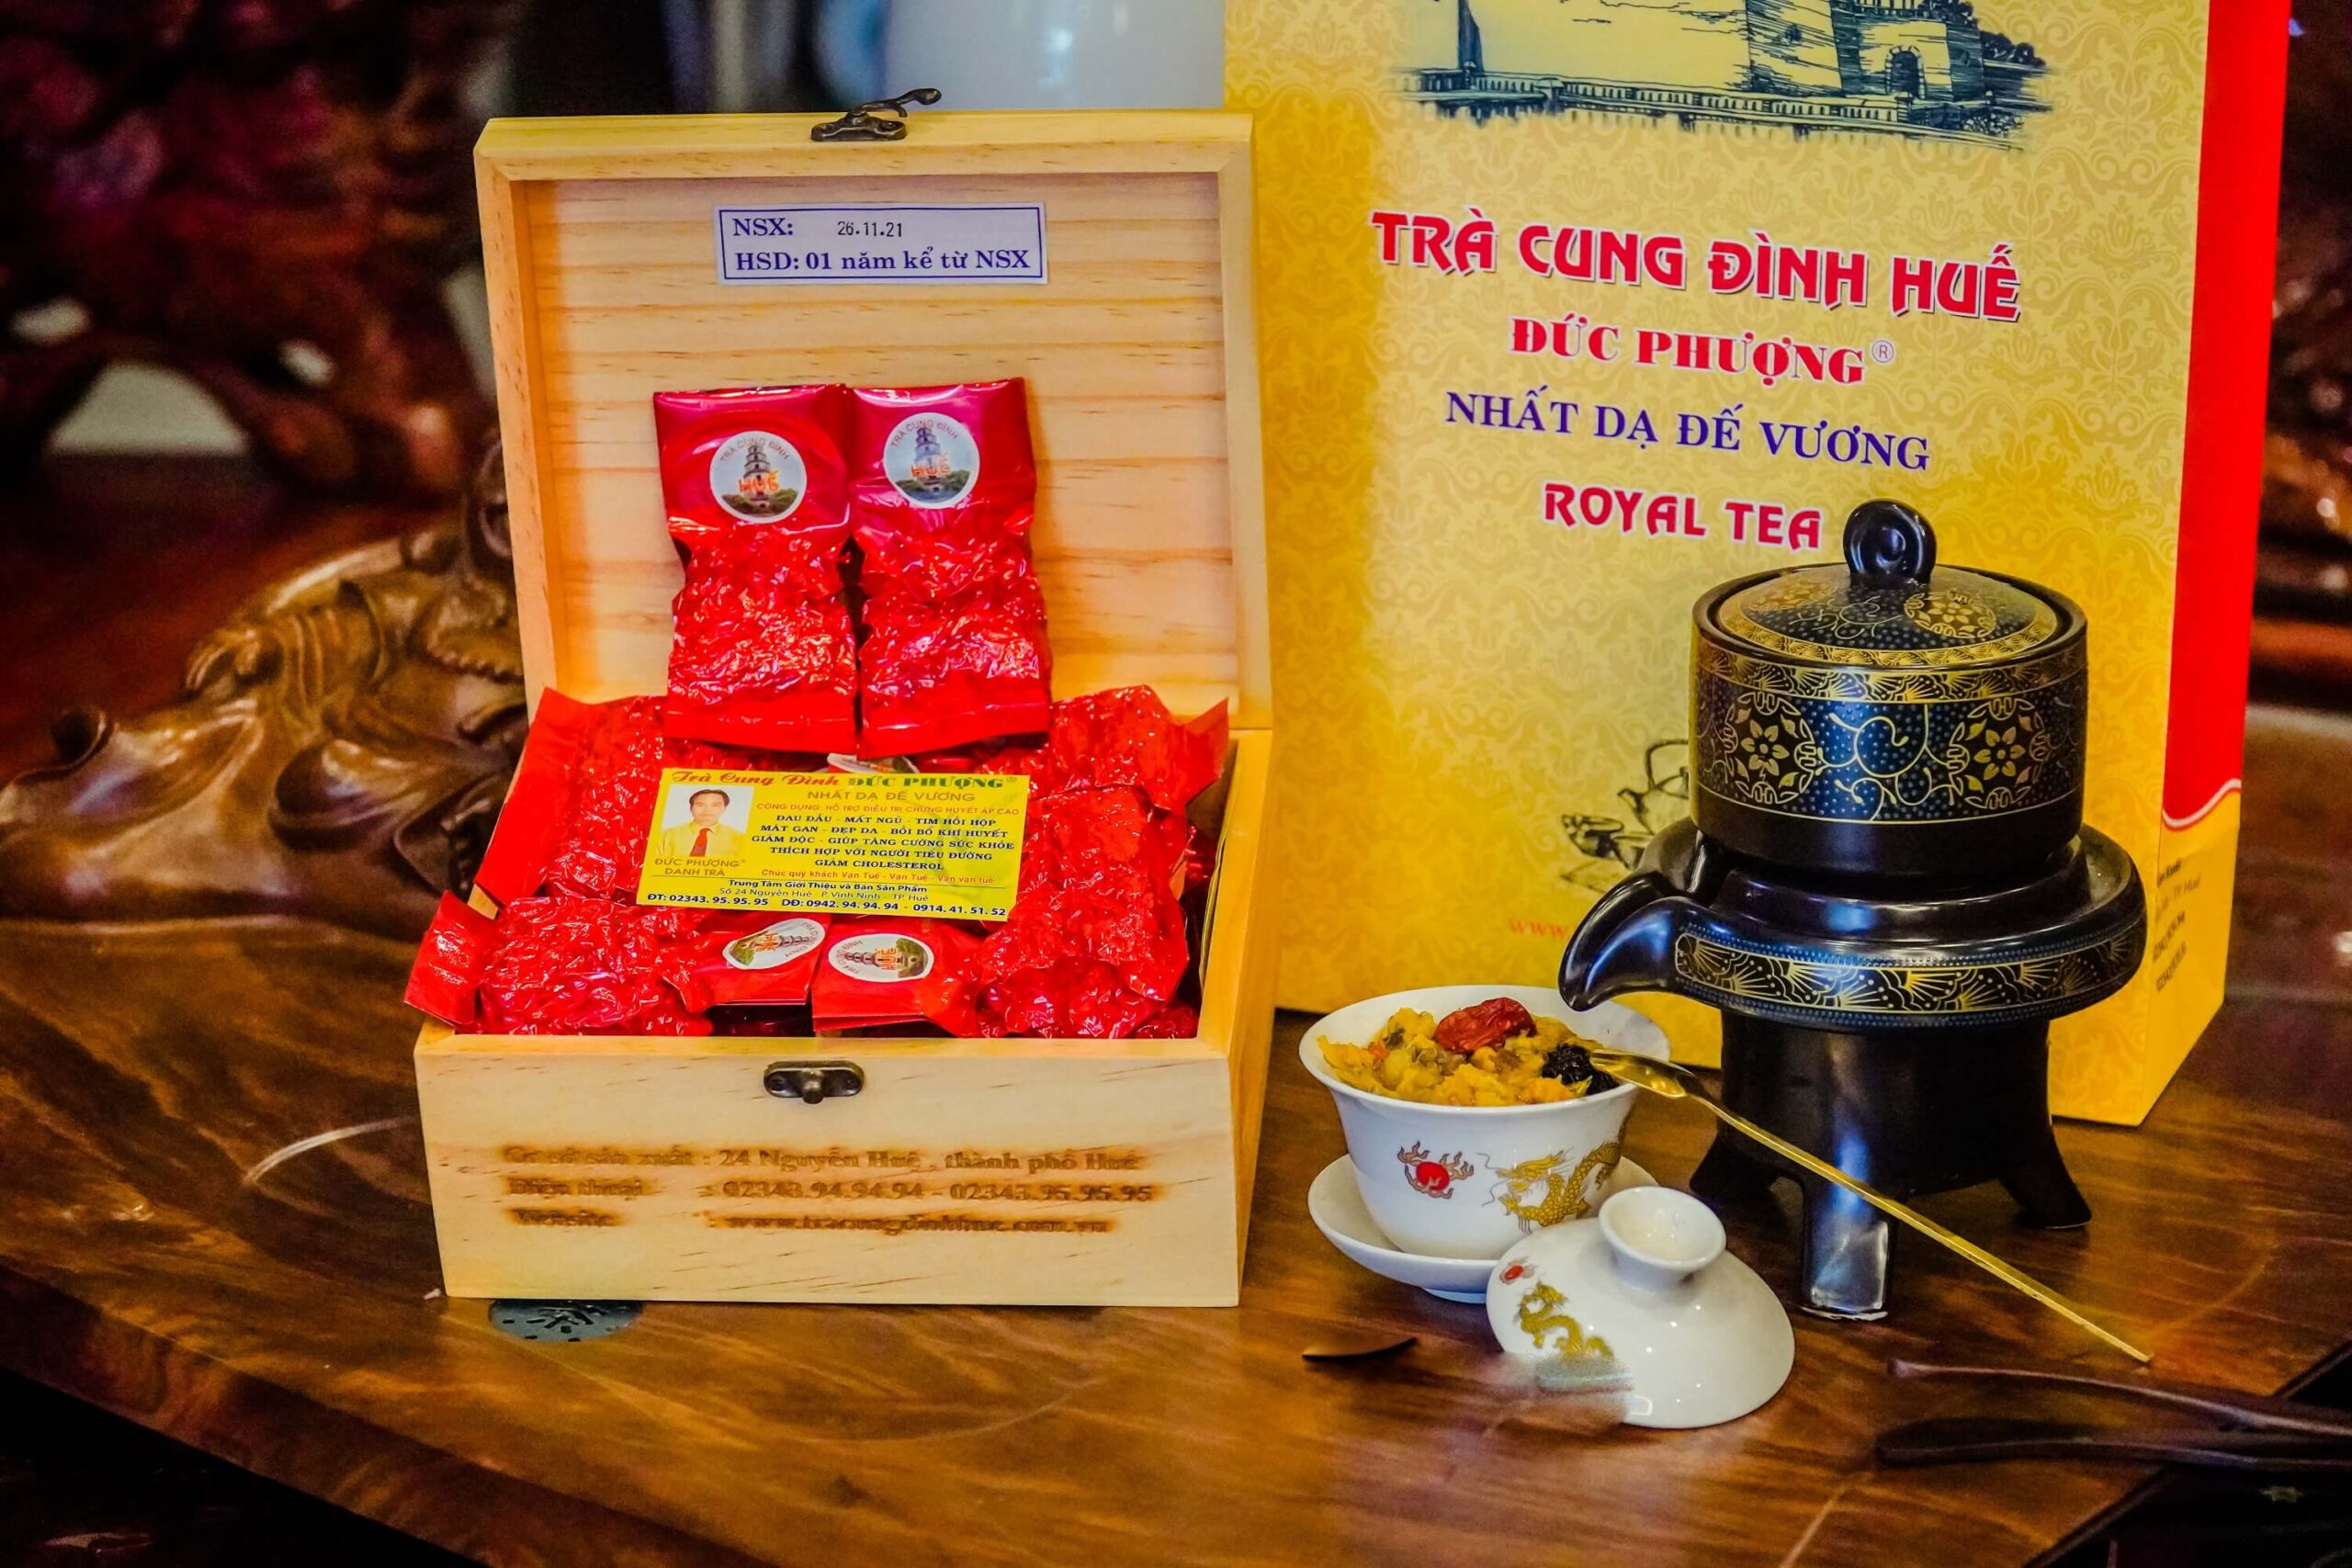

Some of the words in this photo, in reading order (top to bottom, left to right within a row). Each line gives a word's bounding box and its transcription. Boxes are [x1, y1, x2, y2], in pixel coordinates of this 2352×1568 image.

[732, 218, 793, 236] NSX:
[837, 221, 903, 238] 26.11.21
[736, 252, 799, 271] HSD:
[806, 253, 832, 270] 01
[841, 252, 897, 269] năm
[903, 246, 934, 269] kể
[940, 249, 968, 269] từ
[976, 250, 1031, 269] NSX
[1372, 208, 1497, 275] TRÀ
[1518, 224, 1687, 289] CUNG
[1706, 232, 1868, 310] ĐÌNH
[1890, 243, 2022, 321] HUẾ
[1511, 314, 1620, 360] ĐỨC
[1635, 329, 1864, 386] PHƯỢNG
[1445, 386, 1578, 433] NHẤT
[1594, 407, 1658, 450] DẠ
[1677, 403, 1744, 451] ĐẾ
[1759, 420, 1929, 471] VƯƠNG
[1545, 481, 1706, 537] ROYAL
[1724, 501, 1822, 550] TEA
[672, 771, 712, 783] Trà
[720, 773, 775, 785] Cung
[782, 774, 840, 786] Đình
[848, 774, 896, 787] ĐỨC
[903, 776, 1003, 790] PHƯỢNG
[664, 867, 700, 876] DANH
[853, 860, 944, 870] CHOLESTEROL
[719, 1149, 752, 1167] 24
[944, 1150, 1022, 1169] thành
